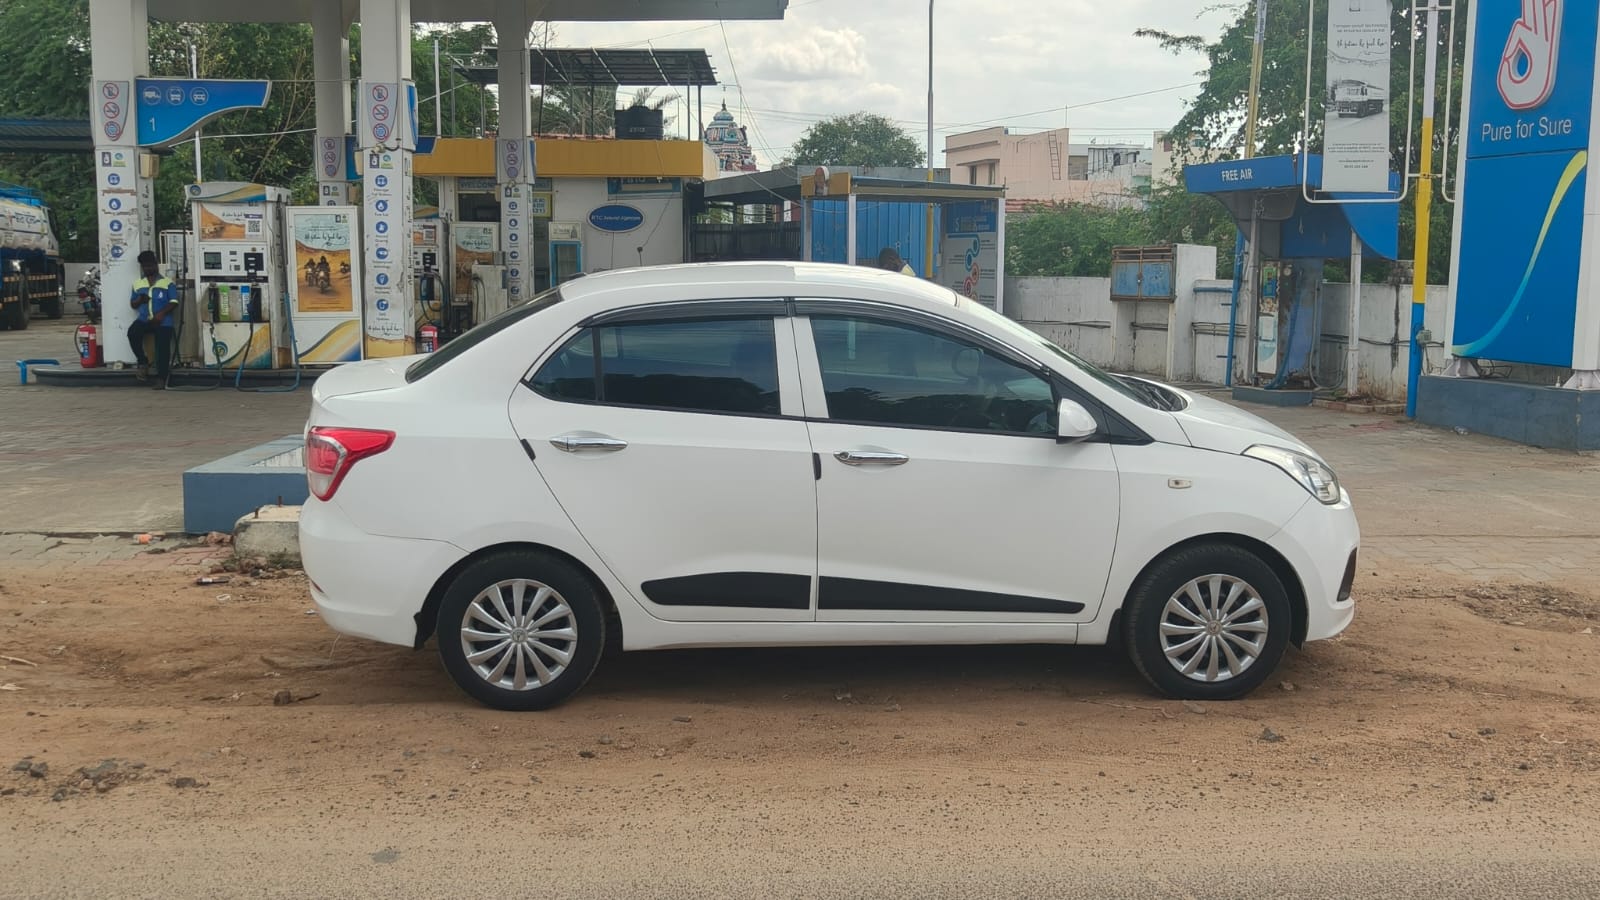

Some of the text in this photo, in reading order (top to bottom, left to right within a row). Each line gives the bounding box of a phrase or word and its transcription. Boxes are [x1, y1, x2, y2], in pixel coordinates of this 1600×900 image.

[149, 117, 155, 132] 1
[1482, 116, 1572, 142] Pure for Sure
[1221, 168, 1253, 182] FREE AIR
